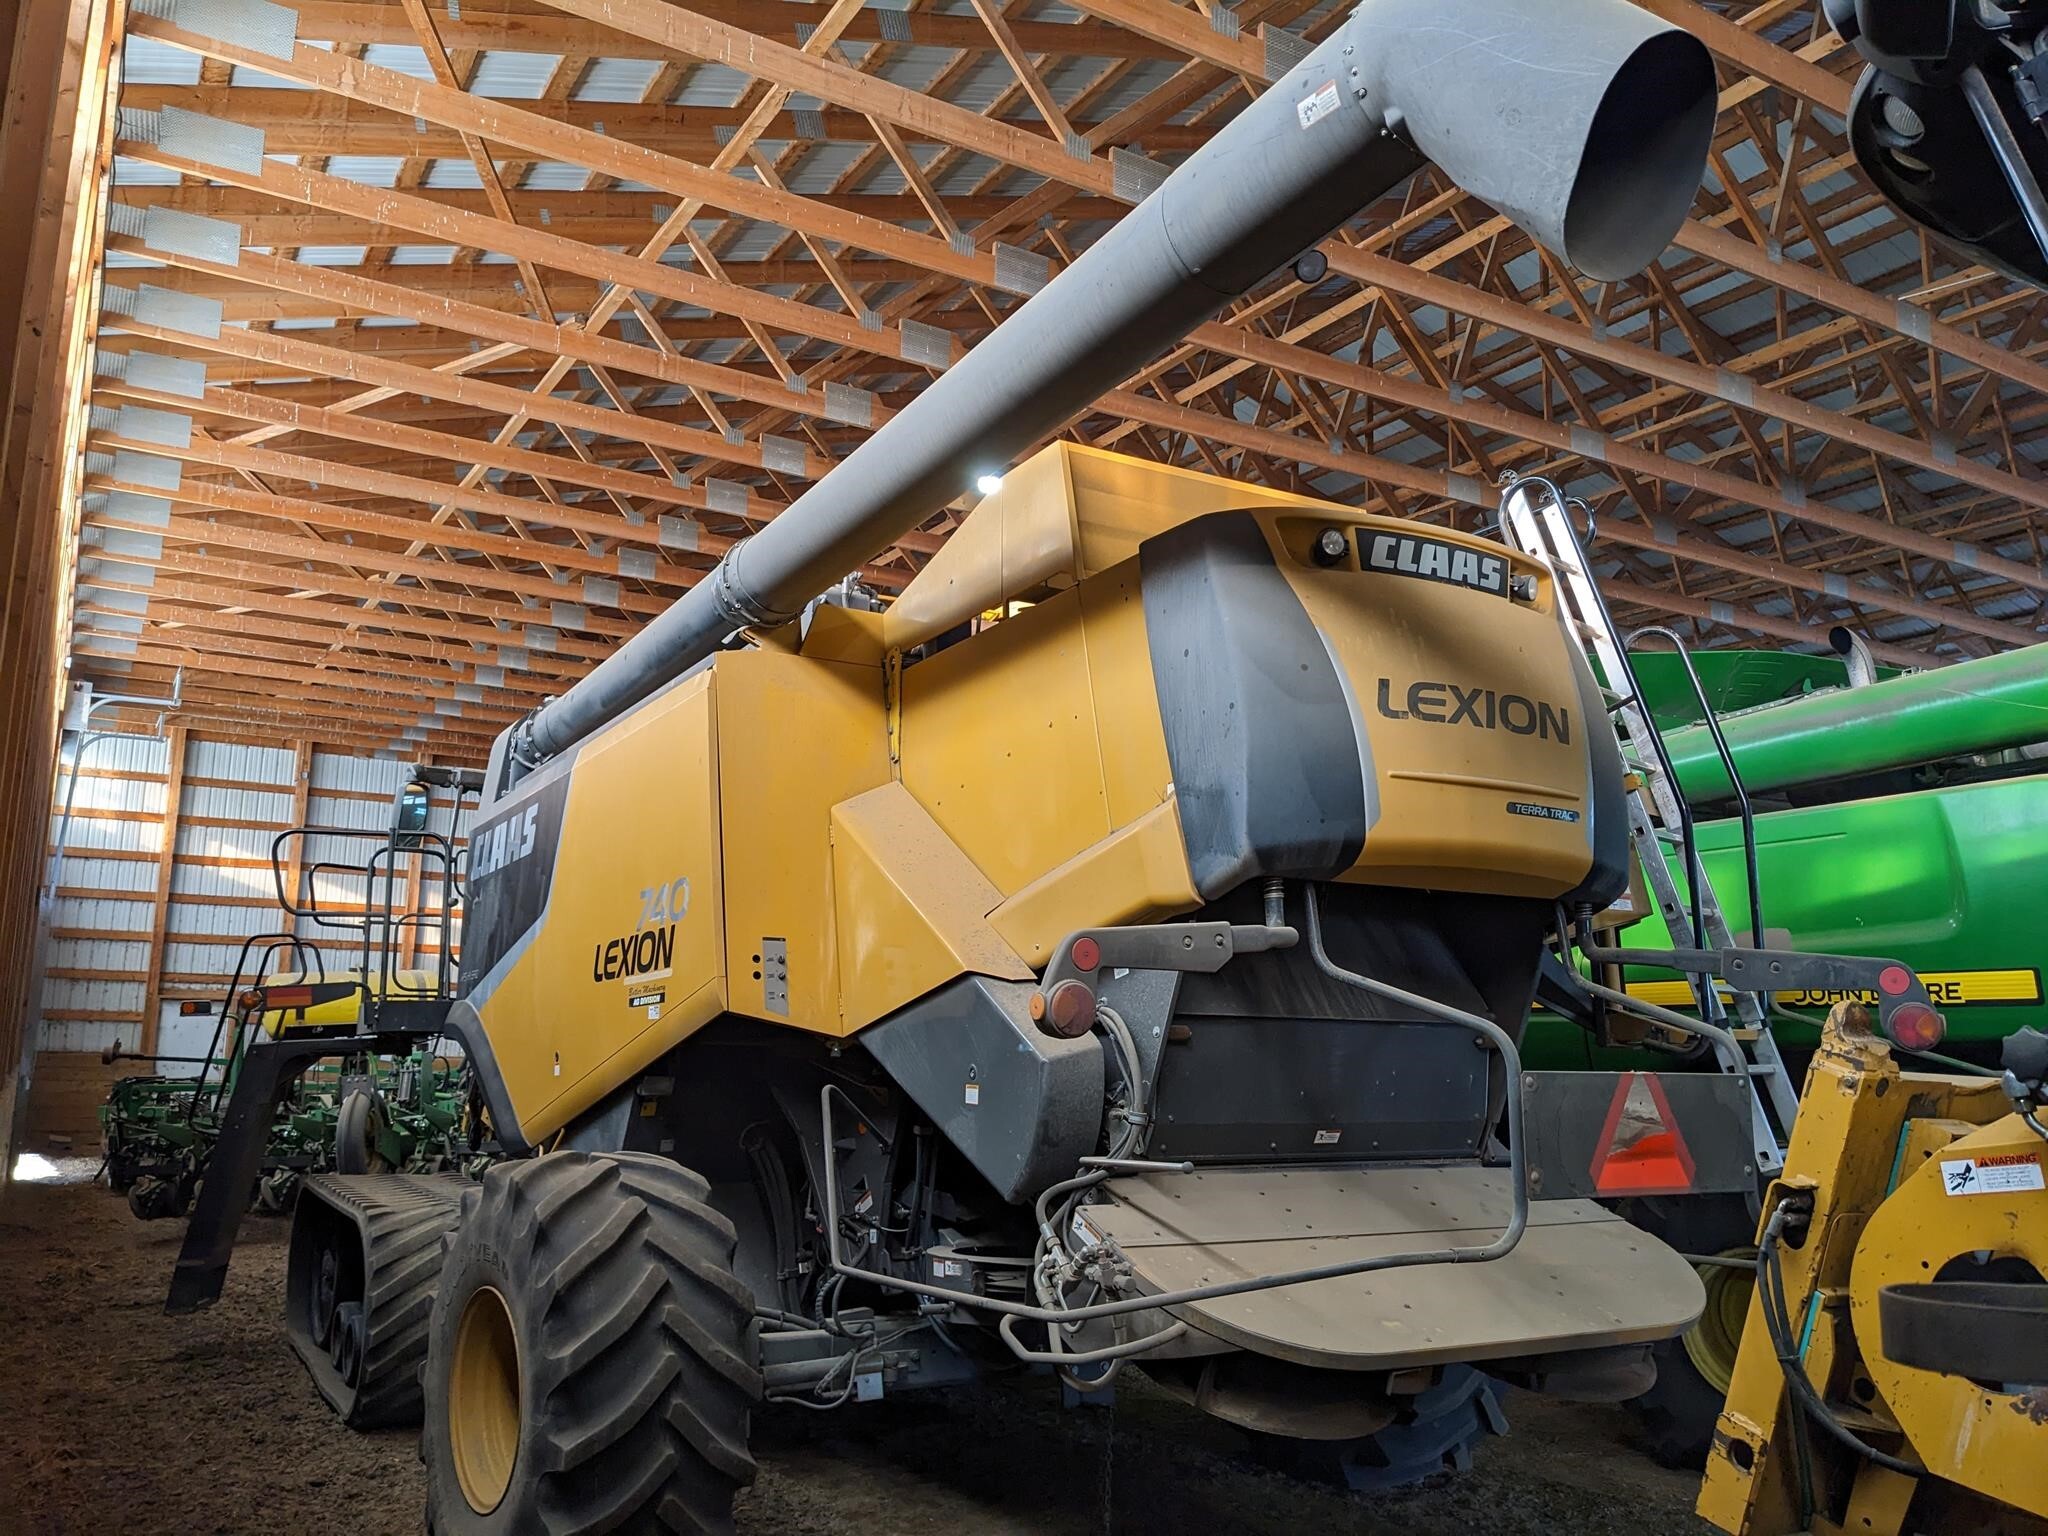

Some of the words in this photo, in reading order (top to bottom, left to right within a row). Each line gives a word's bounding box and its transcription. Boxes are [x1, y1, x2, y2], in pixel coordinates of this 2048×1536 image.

[1370, 535, 1501, 591] CLAAS
[1377, 677, 1571, 746] LEXION
[1515, 804, 1548, 817] TERRA
[1550, 808, 1574, 821] TRAC
[471, 803, 539, 882] CLAAS
[636, 876, 691, 932] 740
[594, 924, 676, 983] LEXION
[1989, 1153, 2036, 1167] WARNING
